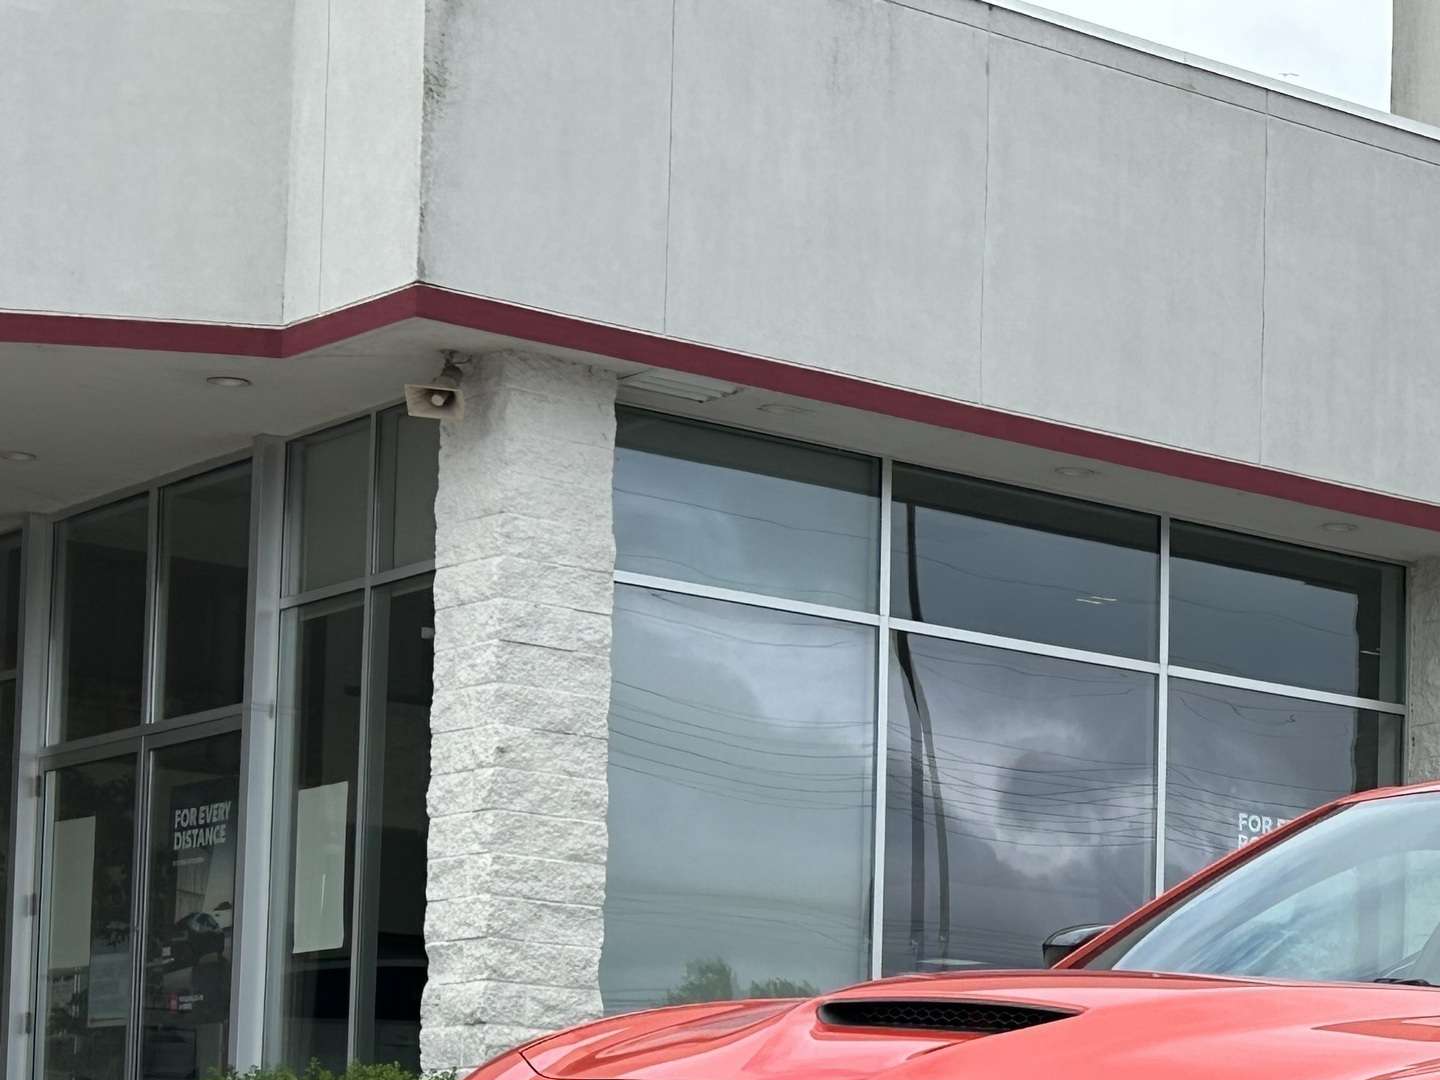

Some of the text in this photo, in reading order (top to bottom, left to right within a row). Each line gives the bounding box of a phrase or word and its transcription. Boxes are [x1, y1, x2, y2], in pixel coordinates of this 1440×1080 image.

[174, 801, 231, 829] FOR EVERY
[1238, 812, 1272, 834] FOR
[174, 824, 226, 850] DISTANCE
